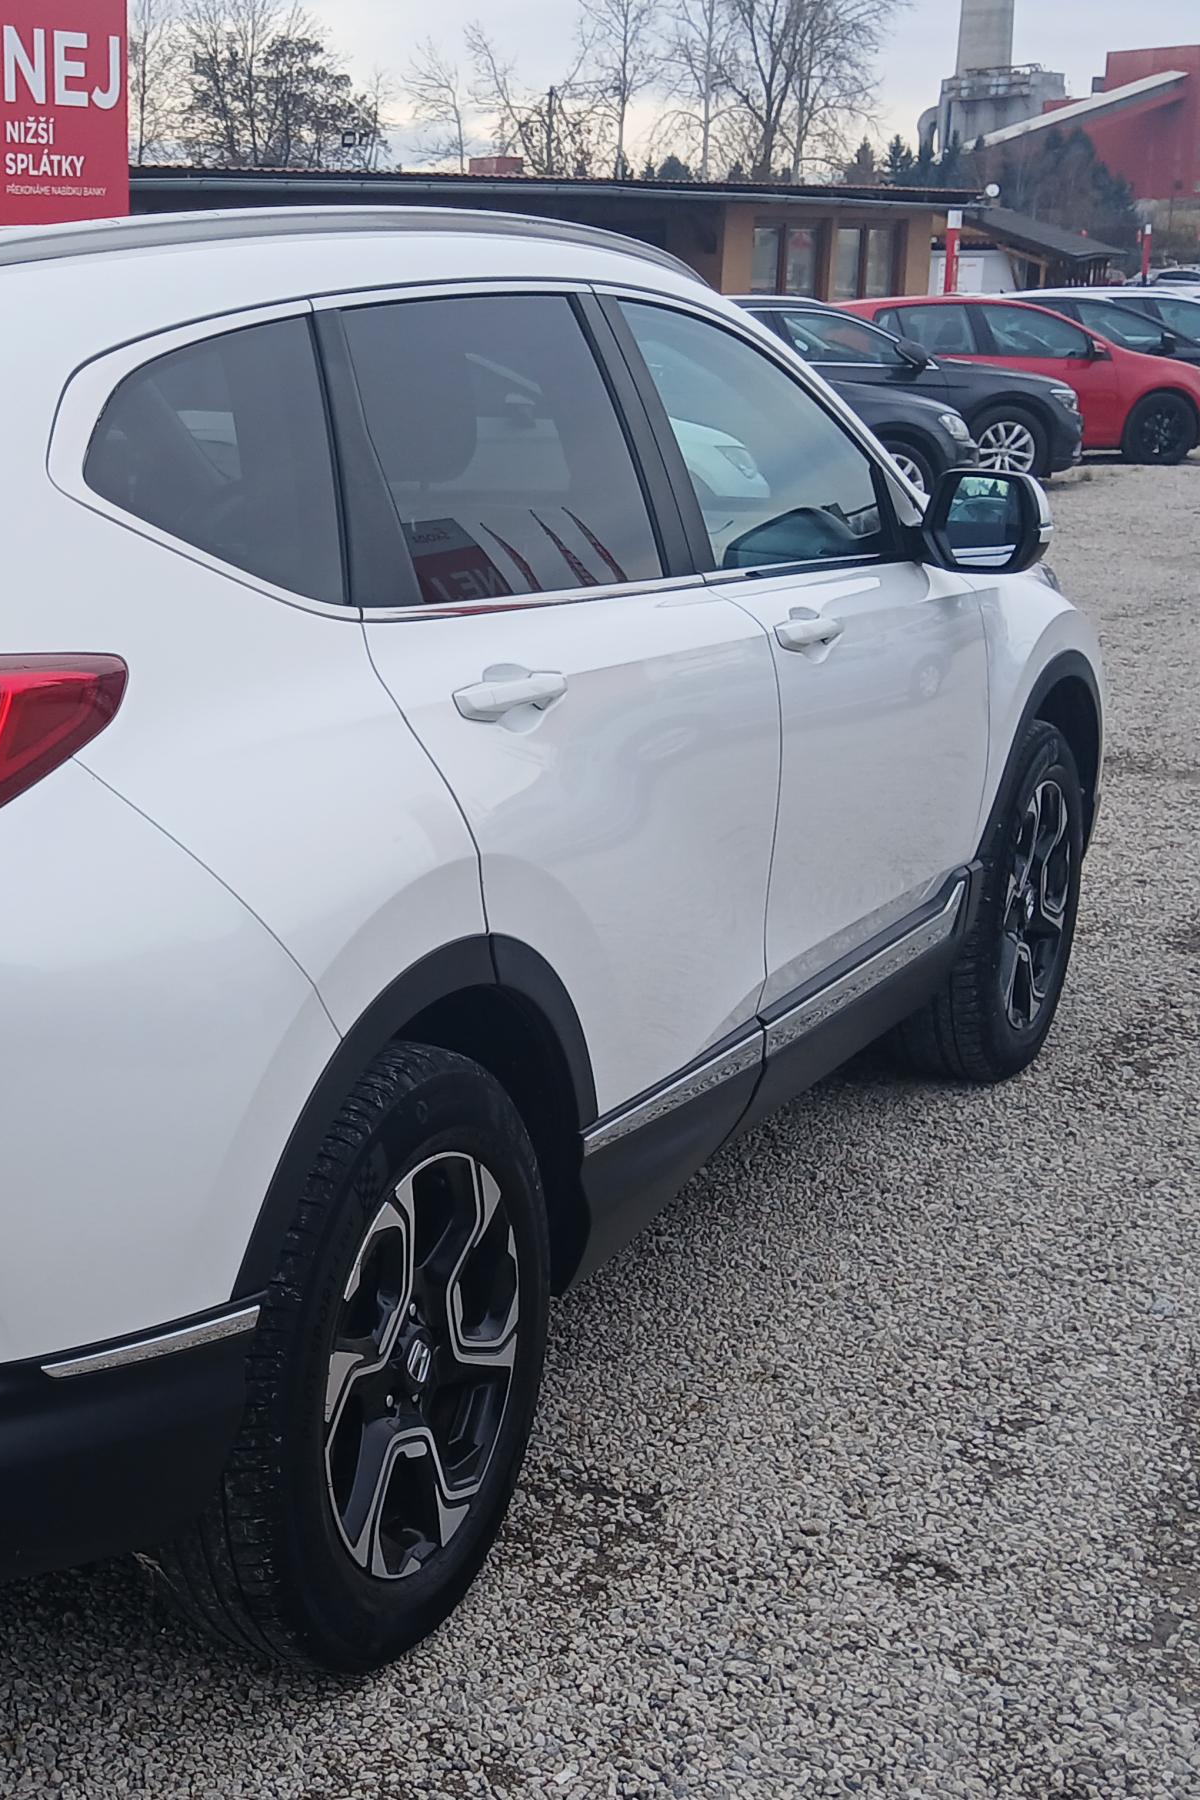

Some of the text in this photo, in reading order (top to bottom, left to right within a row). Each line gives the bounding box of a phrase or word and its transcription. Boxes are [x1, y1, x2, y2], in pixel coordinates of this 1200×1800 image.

[2, 24, 120, 110] NEJ
[5, 116, 54, 145] NIŽŠÍ
[4, 149, 85, 177] SPLÁTKY
